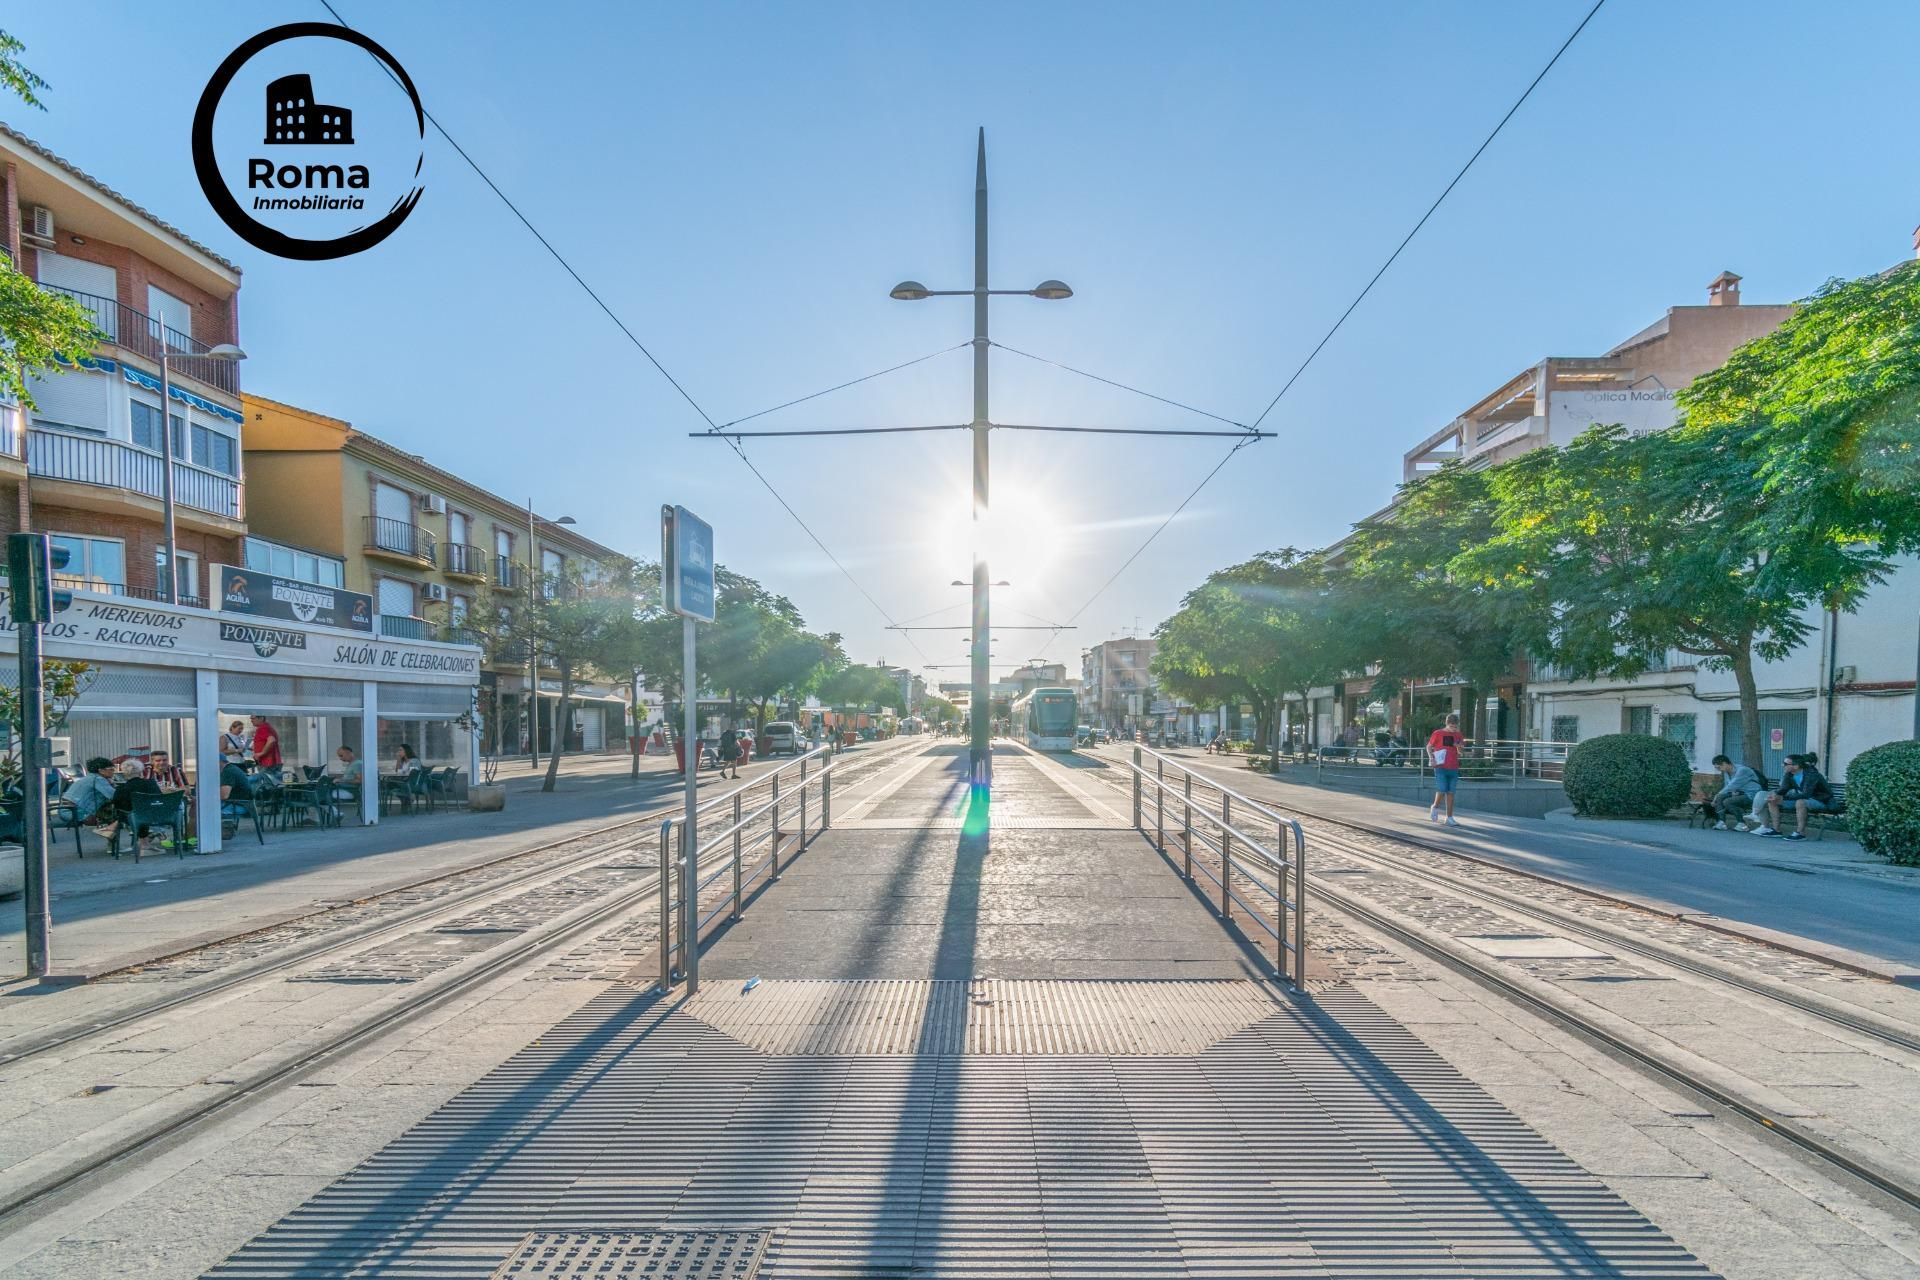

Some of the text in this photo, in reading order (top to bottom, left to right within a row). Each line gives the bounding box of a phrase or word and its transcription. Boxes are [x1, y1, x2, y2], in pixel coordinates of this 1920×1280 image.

[276, 587, 333, 608] PONIENTE
[88, 605, 186, 630] MERIENDAS
[95, 627, 178, 649] RACIONES
[224, 625, 303, 647] PONIENTE
[334, 643, 475, 673] SALÓN DE CELEBRACIONES
